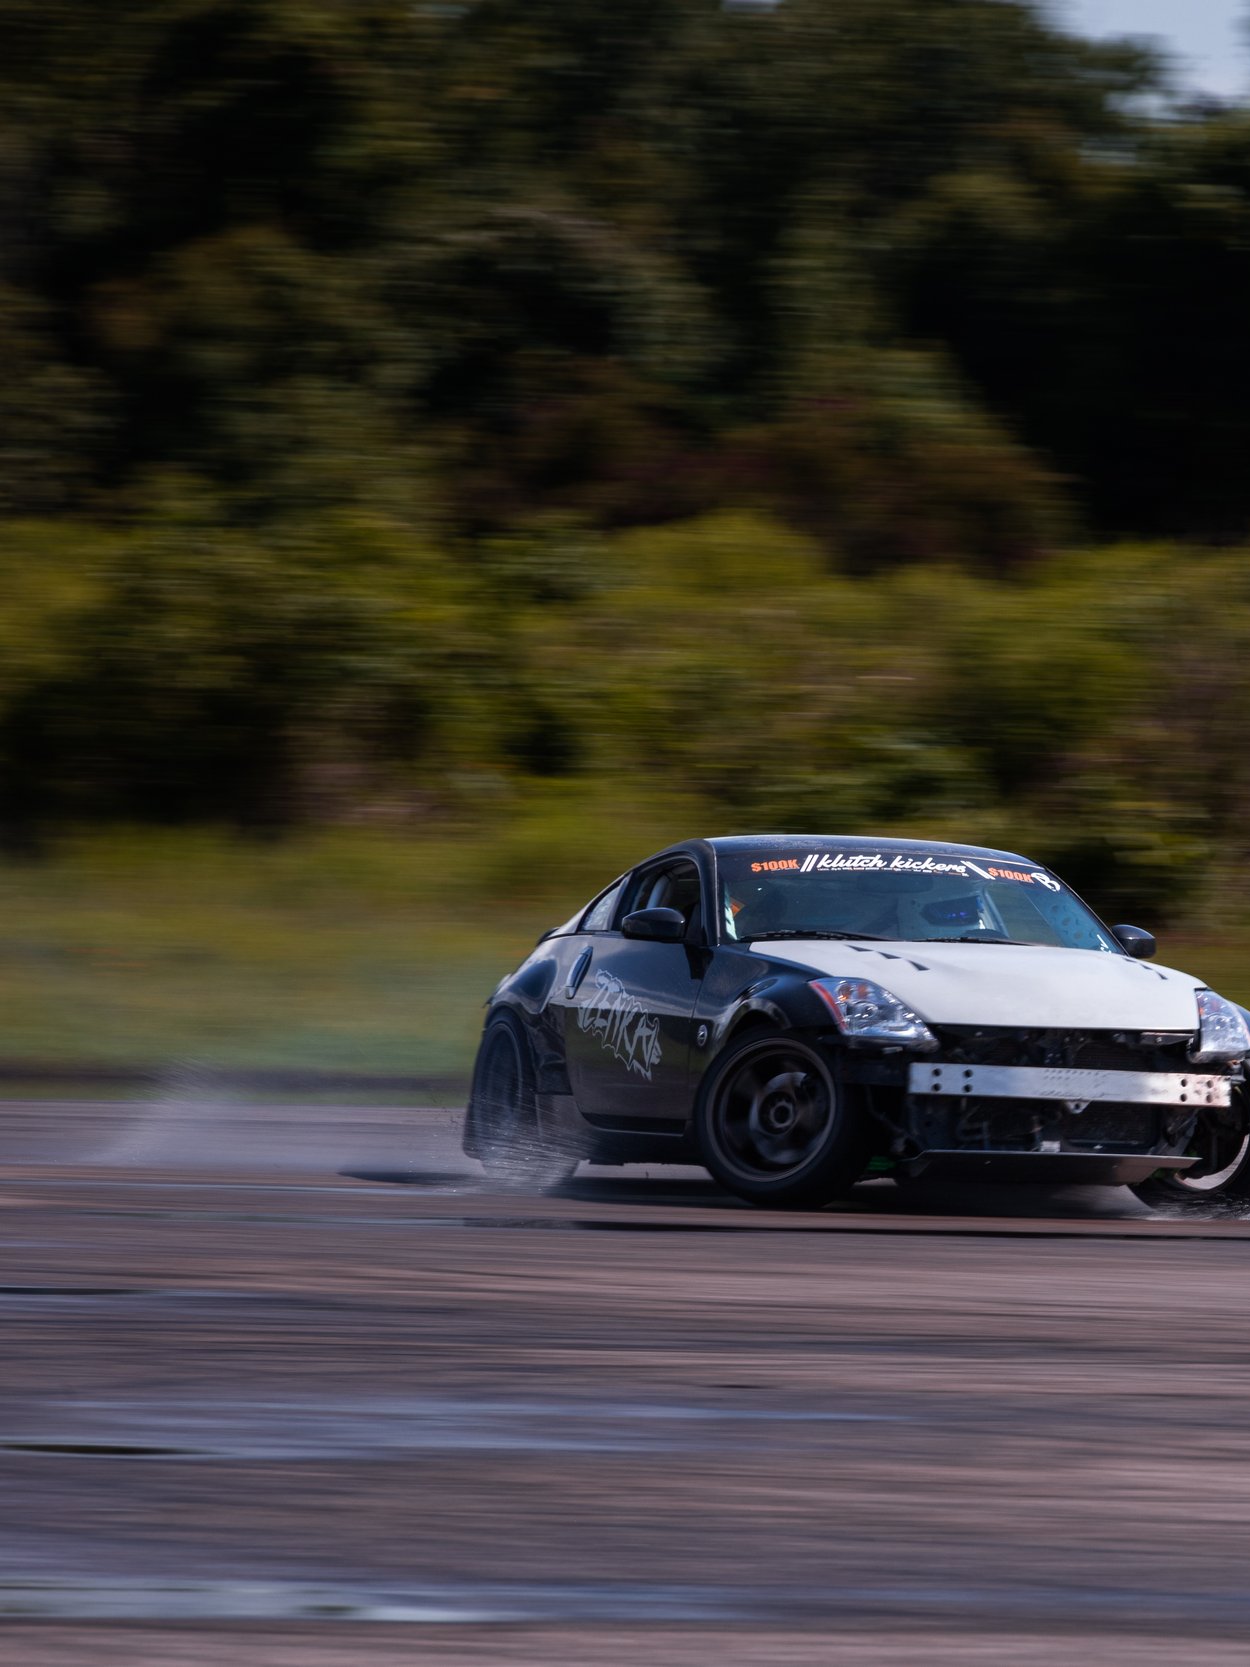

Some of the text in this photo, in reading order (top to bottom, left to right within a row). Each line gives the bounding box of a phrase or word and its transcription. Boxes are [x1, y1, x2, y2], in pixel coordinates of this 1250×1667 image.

[751, 859, 800, 872] $100K
[817, 854, 887, 868] klutch
[890, 856, 967, 873] kickers
[988, 867, 1034, 884] $100K
